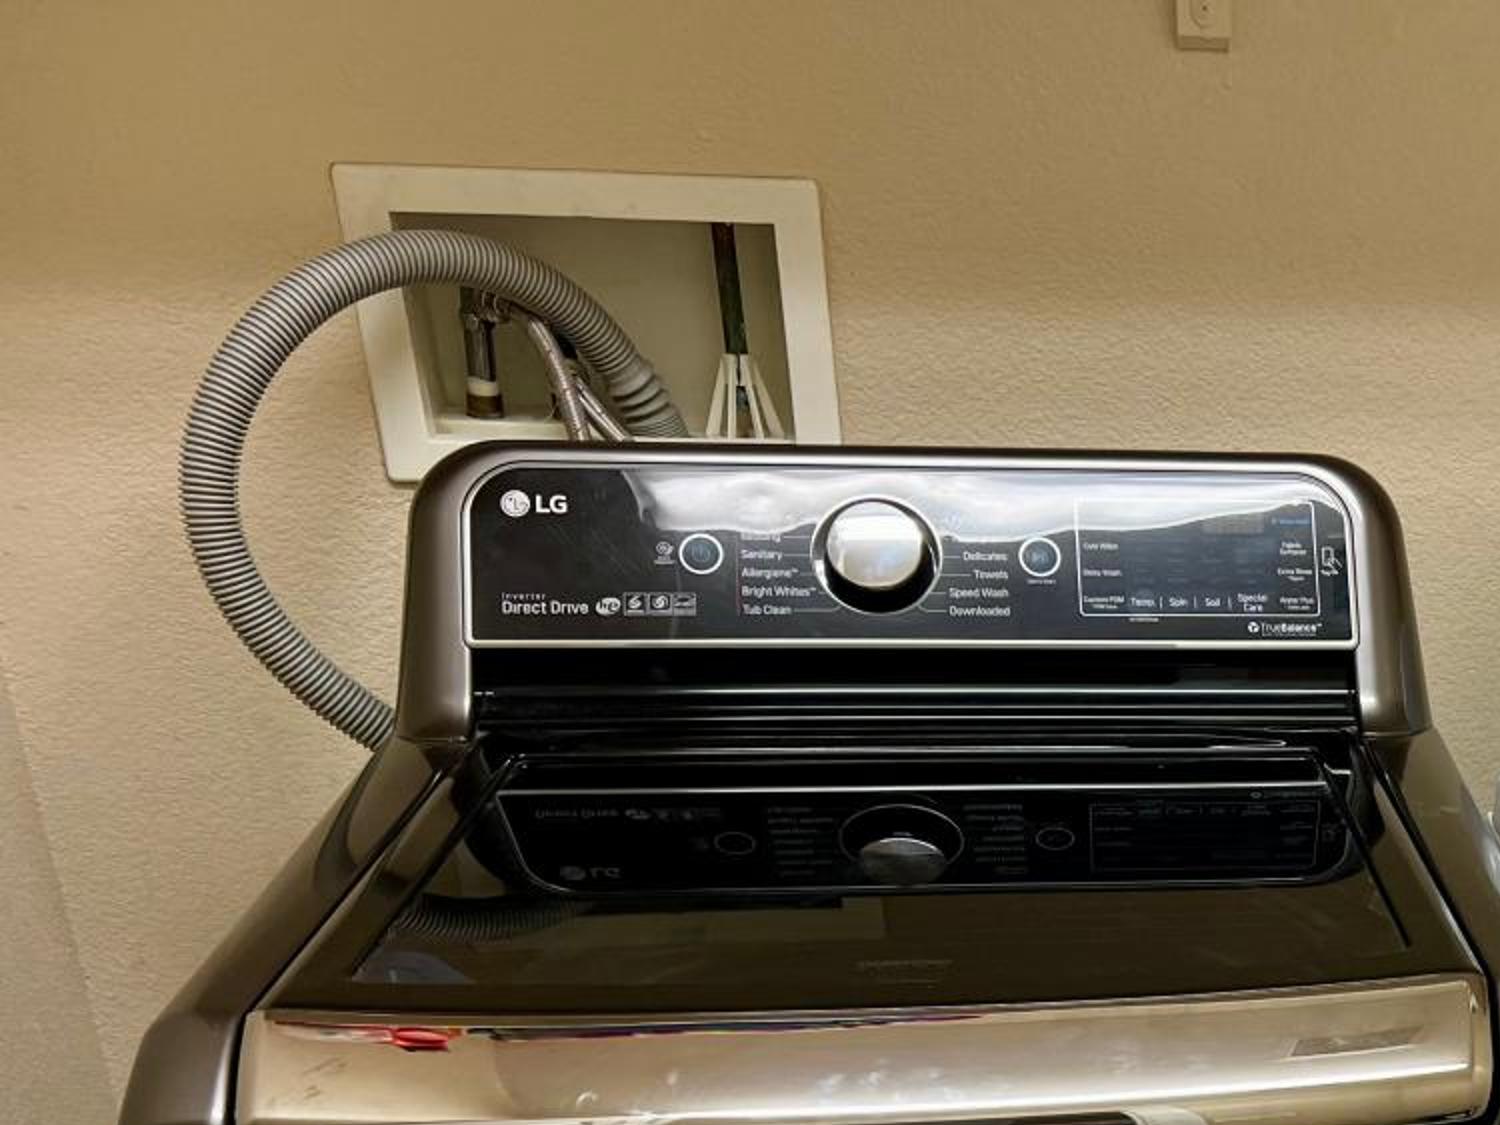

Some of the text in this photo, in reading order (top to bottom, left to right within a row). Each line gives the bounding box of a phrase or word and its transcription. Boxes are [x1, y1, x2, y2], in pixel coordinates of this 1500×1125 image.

[536, 494, 568, 513] LG
[742, 550, 783, 560] Sanitary
[963, 552, 1008, 560] Delicates
[974, 570, 1009, 579] Towels
[742, 585, 773, 598] Bright
[949, 588, 1009, 599] Speed Wash
[1169, 597, 1187, 607] Spin
[1205, 597, 1220, 607] Soil
[502, 601, 589, 615] Direct Drive
[743, 605, 792, 615] Tub Clean
[949, 606, 1011, 616] Downloaded
